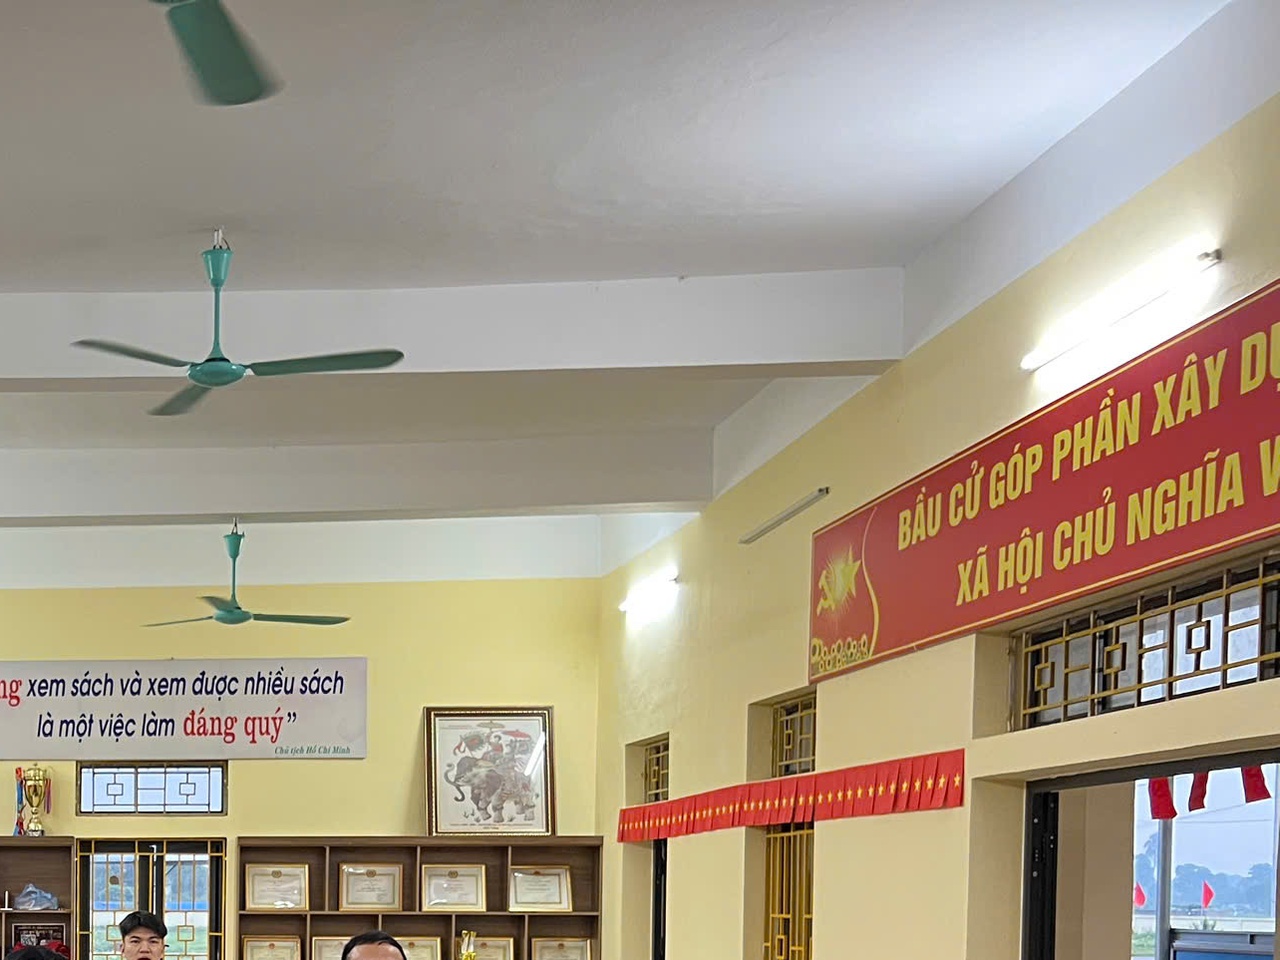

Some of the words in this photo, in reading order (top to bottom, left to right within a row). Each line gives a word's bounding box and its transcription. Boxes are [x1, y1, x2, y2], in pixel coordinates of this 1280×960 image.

[898, 485, 941, 551] BẦU
[949, 461, 984, 527] CỬ
[990, 444, 1042, 509] GÓP
[1052, 388, 1140, 480] PHẦN
[1152, 348, 1226, 435] XÂY
[957, 546, 989, 606] XÃ
[998, 527, 1042, 593] HỘI
[1053, 487, 1116, 569] CHỦ
[1126, 448, 1244, 544] NGHĨA
[27, 677, 65, 698] xem
[71, 670, 113, 697] sách
[120, 671, 142, 697] và
[146, 676, 185, 696] xem
[192, 670, 239, 701] được
[244, 666, 294, 695] nhiều
[299, 670, 344, 695] sách
[37, 712, 53, 737] là
[59, 712, 94, 742] một
[98, 712, 136, 742] việc
[140, 712, 175, 737] làm
[183, 707, 238, 743] đáng
